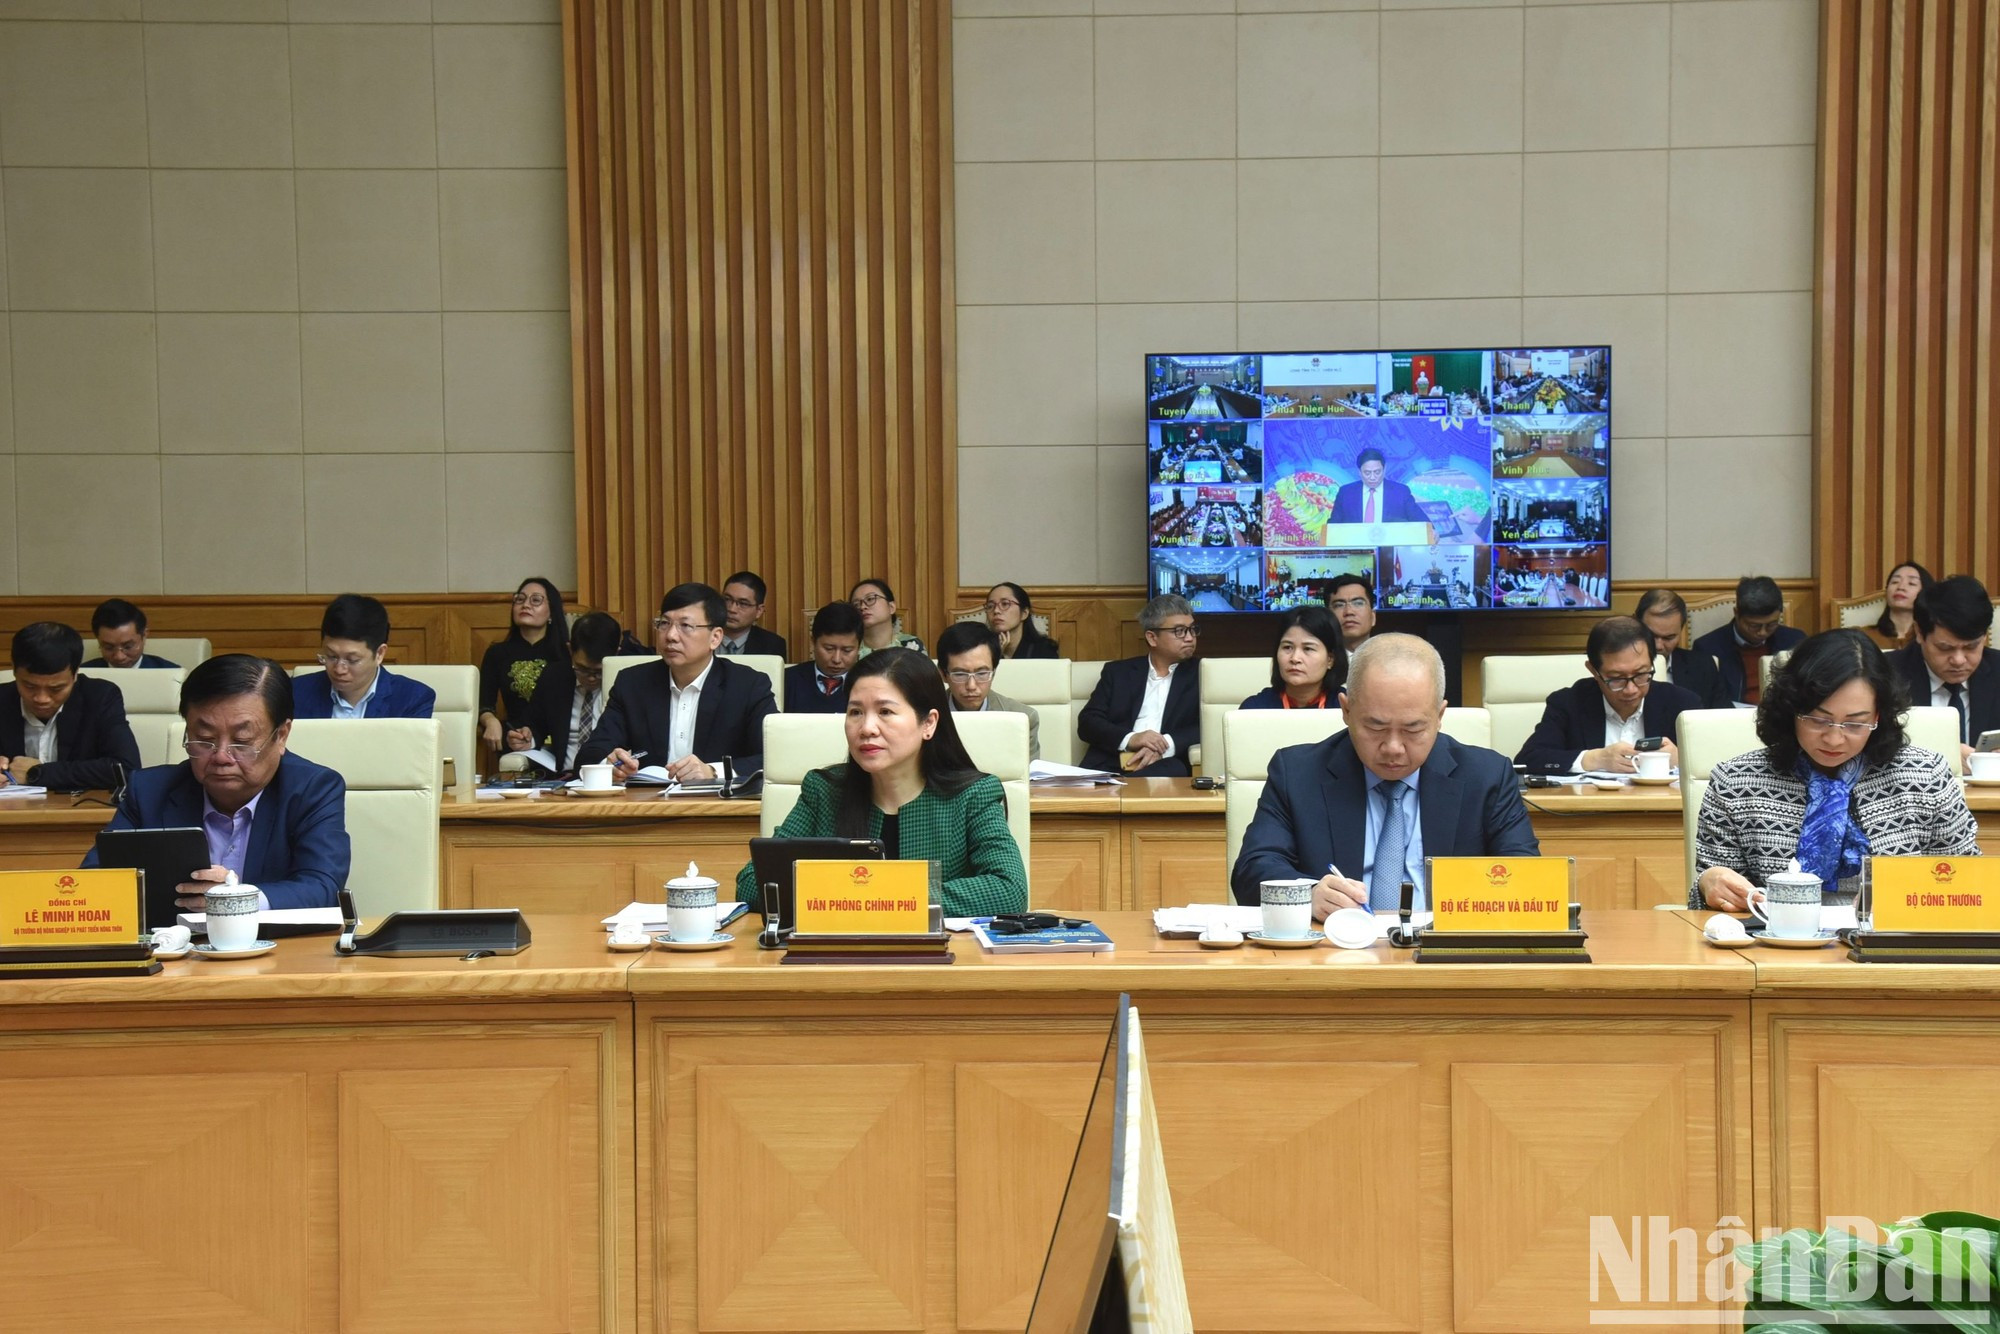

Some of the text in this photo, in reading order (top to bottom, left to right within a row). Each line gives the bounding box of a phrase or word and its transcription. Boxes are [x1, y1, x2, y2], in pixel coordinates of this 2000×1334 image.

[1158, 407, 1186, 418] Tuyen
[1298, 404, 1324, 413] Thien
[1327, 404, 1345, 413] Hue
[1502, 465, 1523, 475] Vinh
[1502, 530, 1520, 539] Yen
[73, 897, 86, 906] CHÍ
[806, 896, 917, 912] VĂN PHÒNG CHÍNH PHỦ
[1440, 896, 1559, 915] BỘ KẾ HOẠCH VÀ ĐẦU TƯ
[1906, 892, 1982, 909] BỘ CÔNG THƯƠNG
[25, 908, 111, 923] LÊ MINH HOAN
[449, 926, 489, 937] BOSCH
